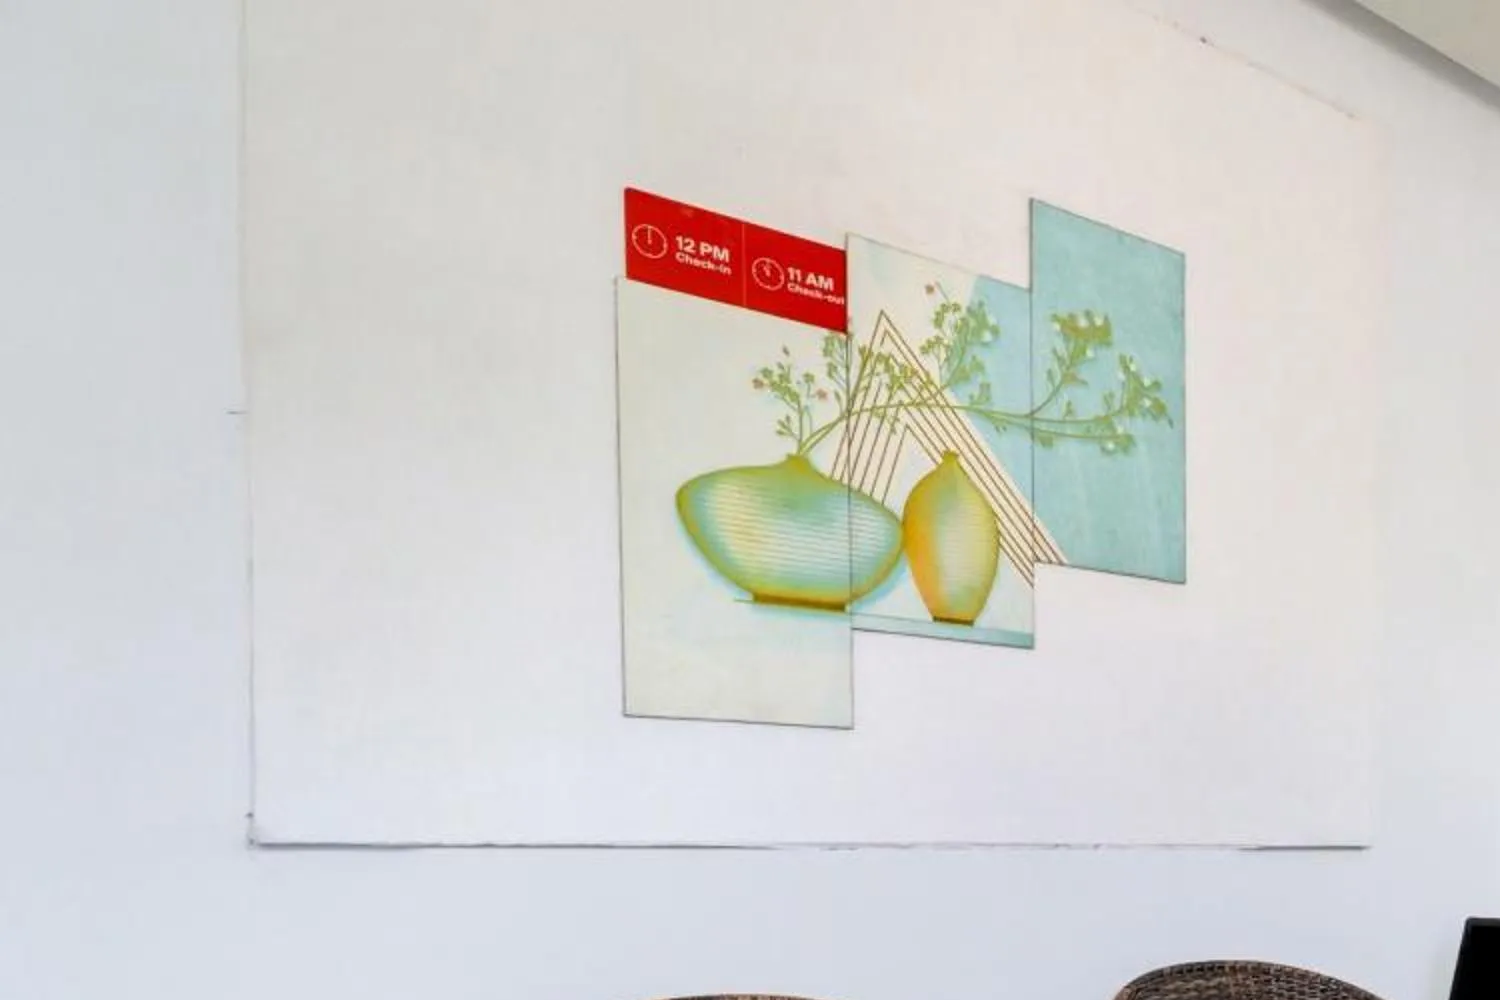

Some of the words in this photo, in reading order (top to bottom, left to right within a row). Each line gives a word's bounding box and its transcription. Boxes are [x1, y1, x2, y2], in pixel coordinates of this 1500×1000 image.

[675, 235, 697, 255] 12
[699, 241, 730, 263] PM
[675, 252, 732, 275] Check-in
[787, 266, 802, 282] 11
[805, 272, 834, 292] AM
